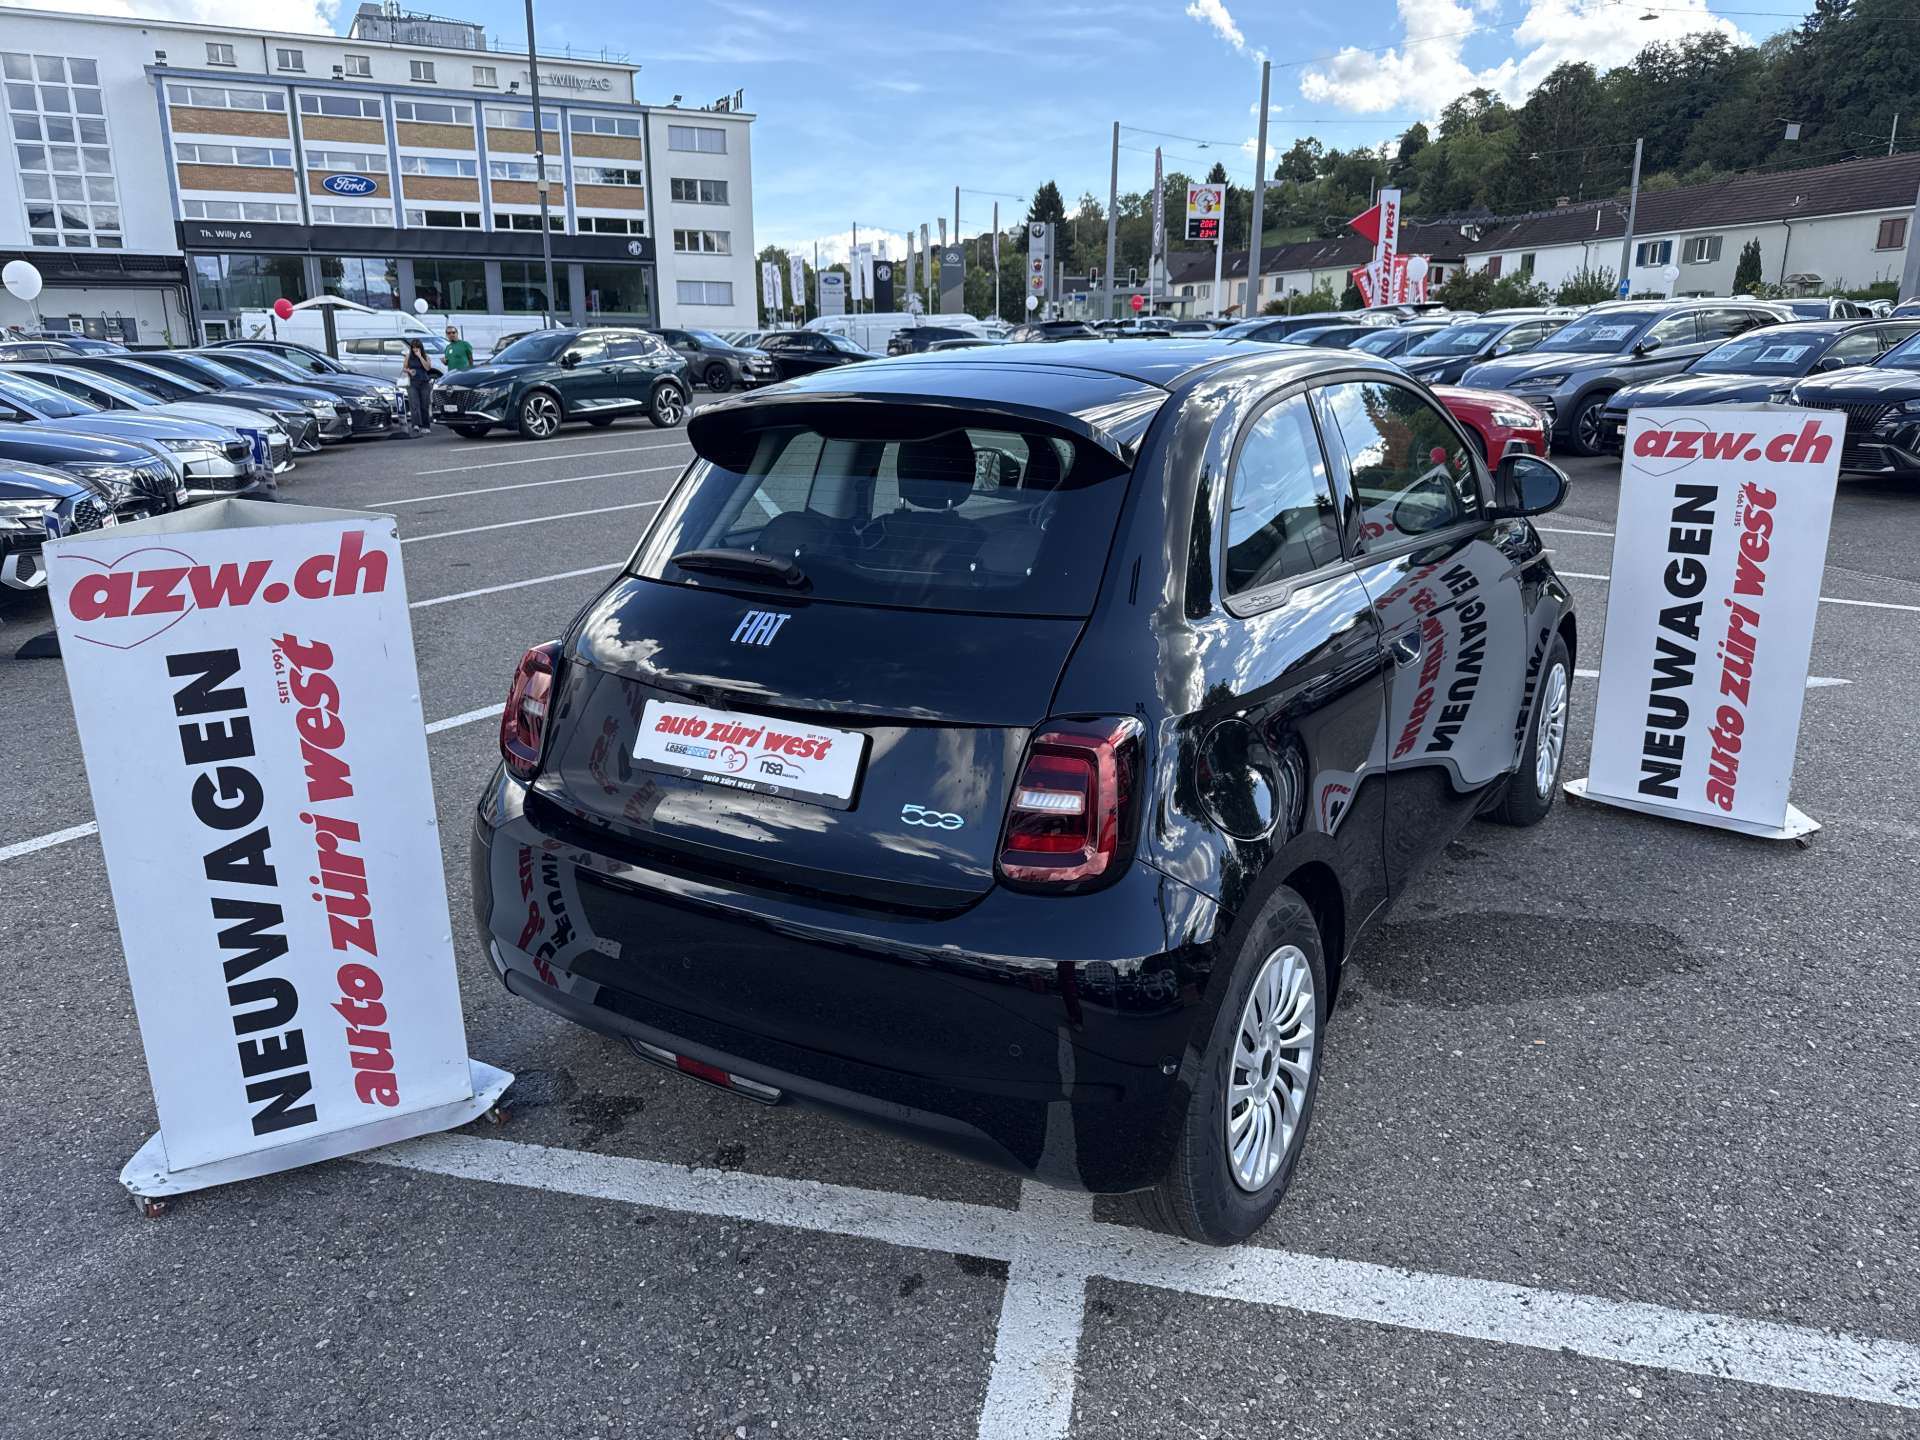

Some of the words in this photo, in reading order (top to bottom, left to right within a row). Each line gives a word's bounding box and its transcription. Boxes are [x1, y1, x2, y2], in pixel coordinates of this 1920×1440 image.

[552, 72, 585, 91] Willy
[589, 78, 612, 90] AG
[334, 176, 367, 191] Ford
[200, 229, 213, 237] Th.
[215, 230, 237, 240] Willy
[239, 231, 252, 239] AG
[1385, 201, 1396, 239] west
[1633, 420, 1832, 464] azw.ch
[1734, 511, 1742, 527] SEIT
[1736, 489, 1745, 508] 1991
[1734, 481, 1777, 596] west
[68, 530, 389, 621] azw.ch
[730, 610, 791, 646] FIAT
[1638, 483, 1718, 800] NEUWAGEN
[272, 648, 286, 676] 1991
[1716, 598, 1760, 706] züri
[279, 680, 290, 704] SEIT
[272, 632, 354, 803] west
[655, 715, 706, 738] auto
[705, 720, 765, 749] züri
[764, 731, 832, 760] west
[760, 760, 783, 776] nsa
[1706, 705, 1744, 812] auto
[702, 774, 720, 784] auto
[737, 780, 756, 791] west
[166, 648, 318, 1136] NEUWAGEN
[299, 811, 378, 958] züri
[330, 963, 400, 1107] auto
